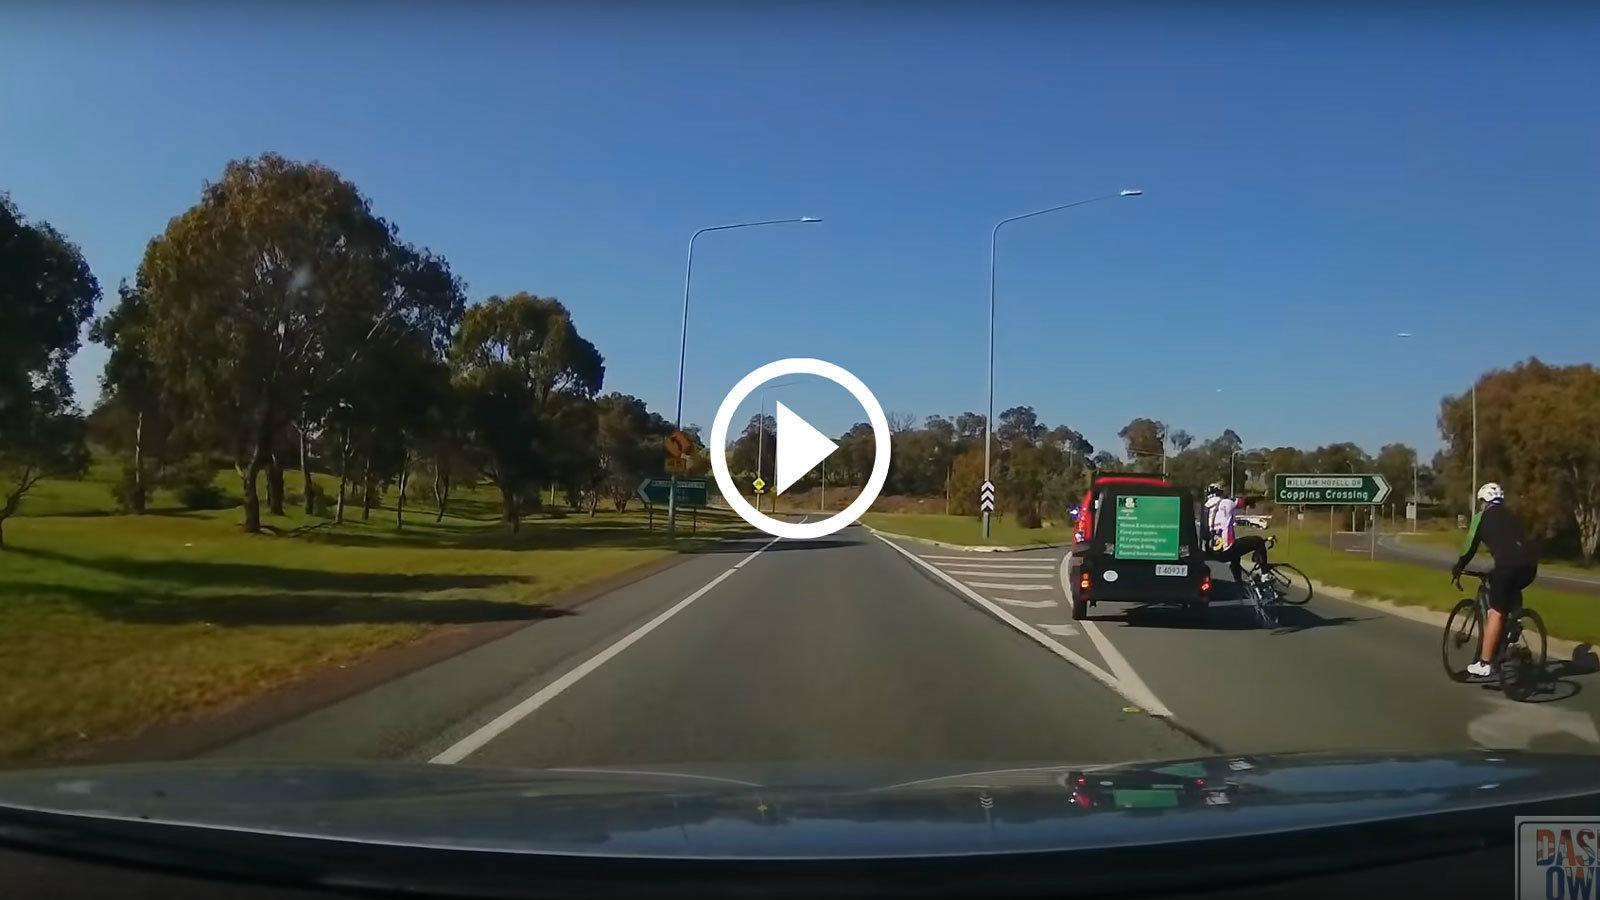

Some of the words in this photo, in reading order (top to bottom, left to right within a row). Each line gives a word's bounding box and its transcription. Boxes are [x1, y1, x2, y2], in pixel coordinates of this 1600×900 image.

[1286, 479, 1318, 487] WILLIAM
[1280, 490, 1321, 500] Coppins
[1325, 490, 1368, 501] Crossing
